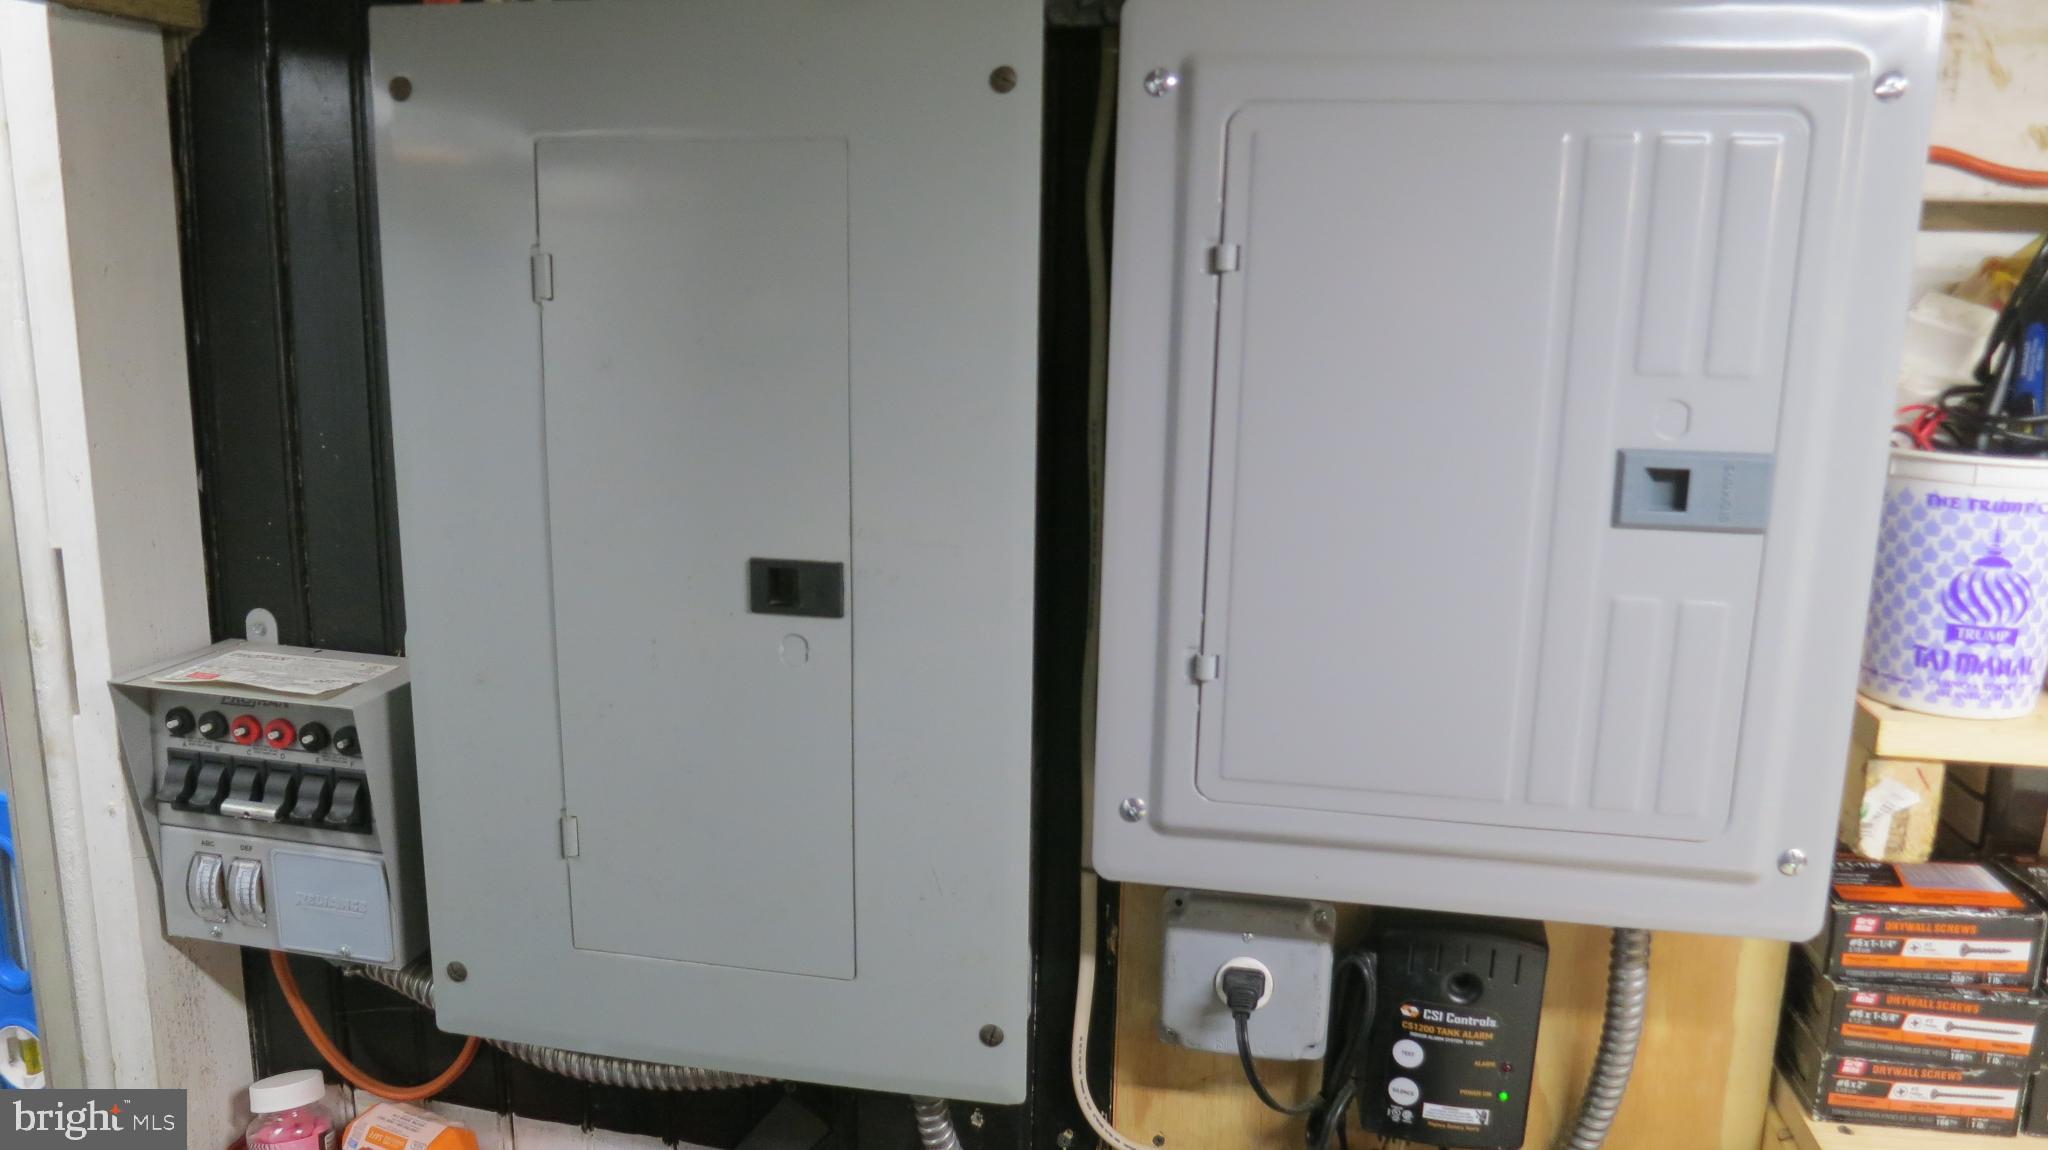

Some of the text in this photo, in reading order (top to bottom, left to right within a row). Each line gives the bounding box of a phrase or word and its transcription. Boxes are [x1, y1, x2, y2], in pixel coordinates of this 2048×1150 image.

[1957, 627, 2011, 642] TRUMP
[1912, 643, 2034, 677] TAJ MAHAL
[1885, 921, 1978, 935] DRYWALL SCREWS
[1886, 994, 1980, 1013] DRYWALL SCREWS
[1423, 1008, 1497, 1028] CSI Controls
[1437, 1026, 1460, 1037] TANK
[1462, 1029, 1494, 1041] ALARM
[1401, 1049, 1415, 1057] TEST
[1474, 1060, 1496, 1068] ALARM
[1872, 1065, 1963, 1081] DRYWALL SCREWS
